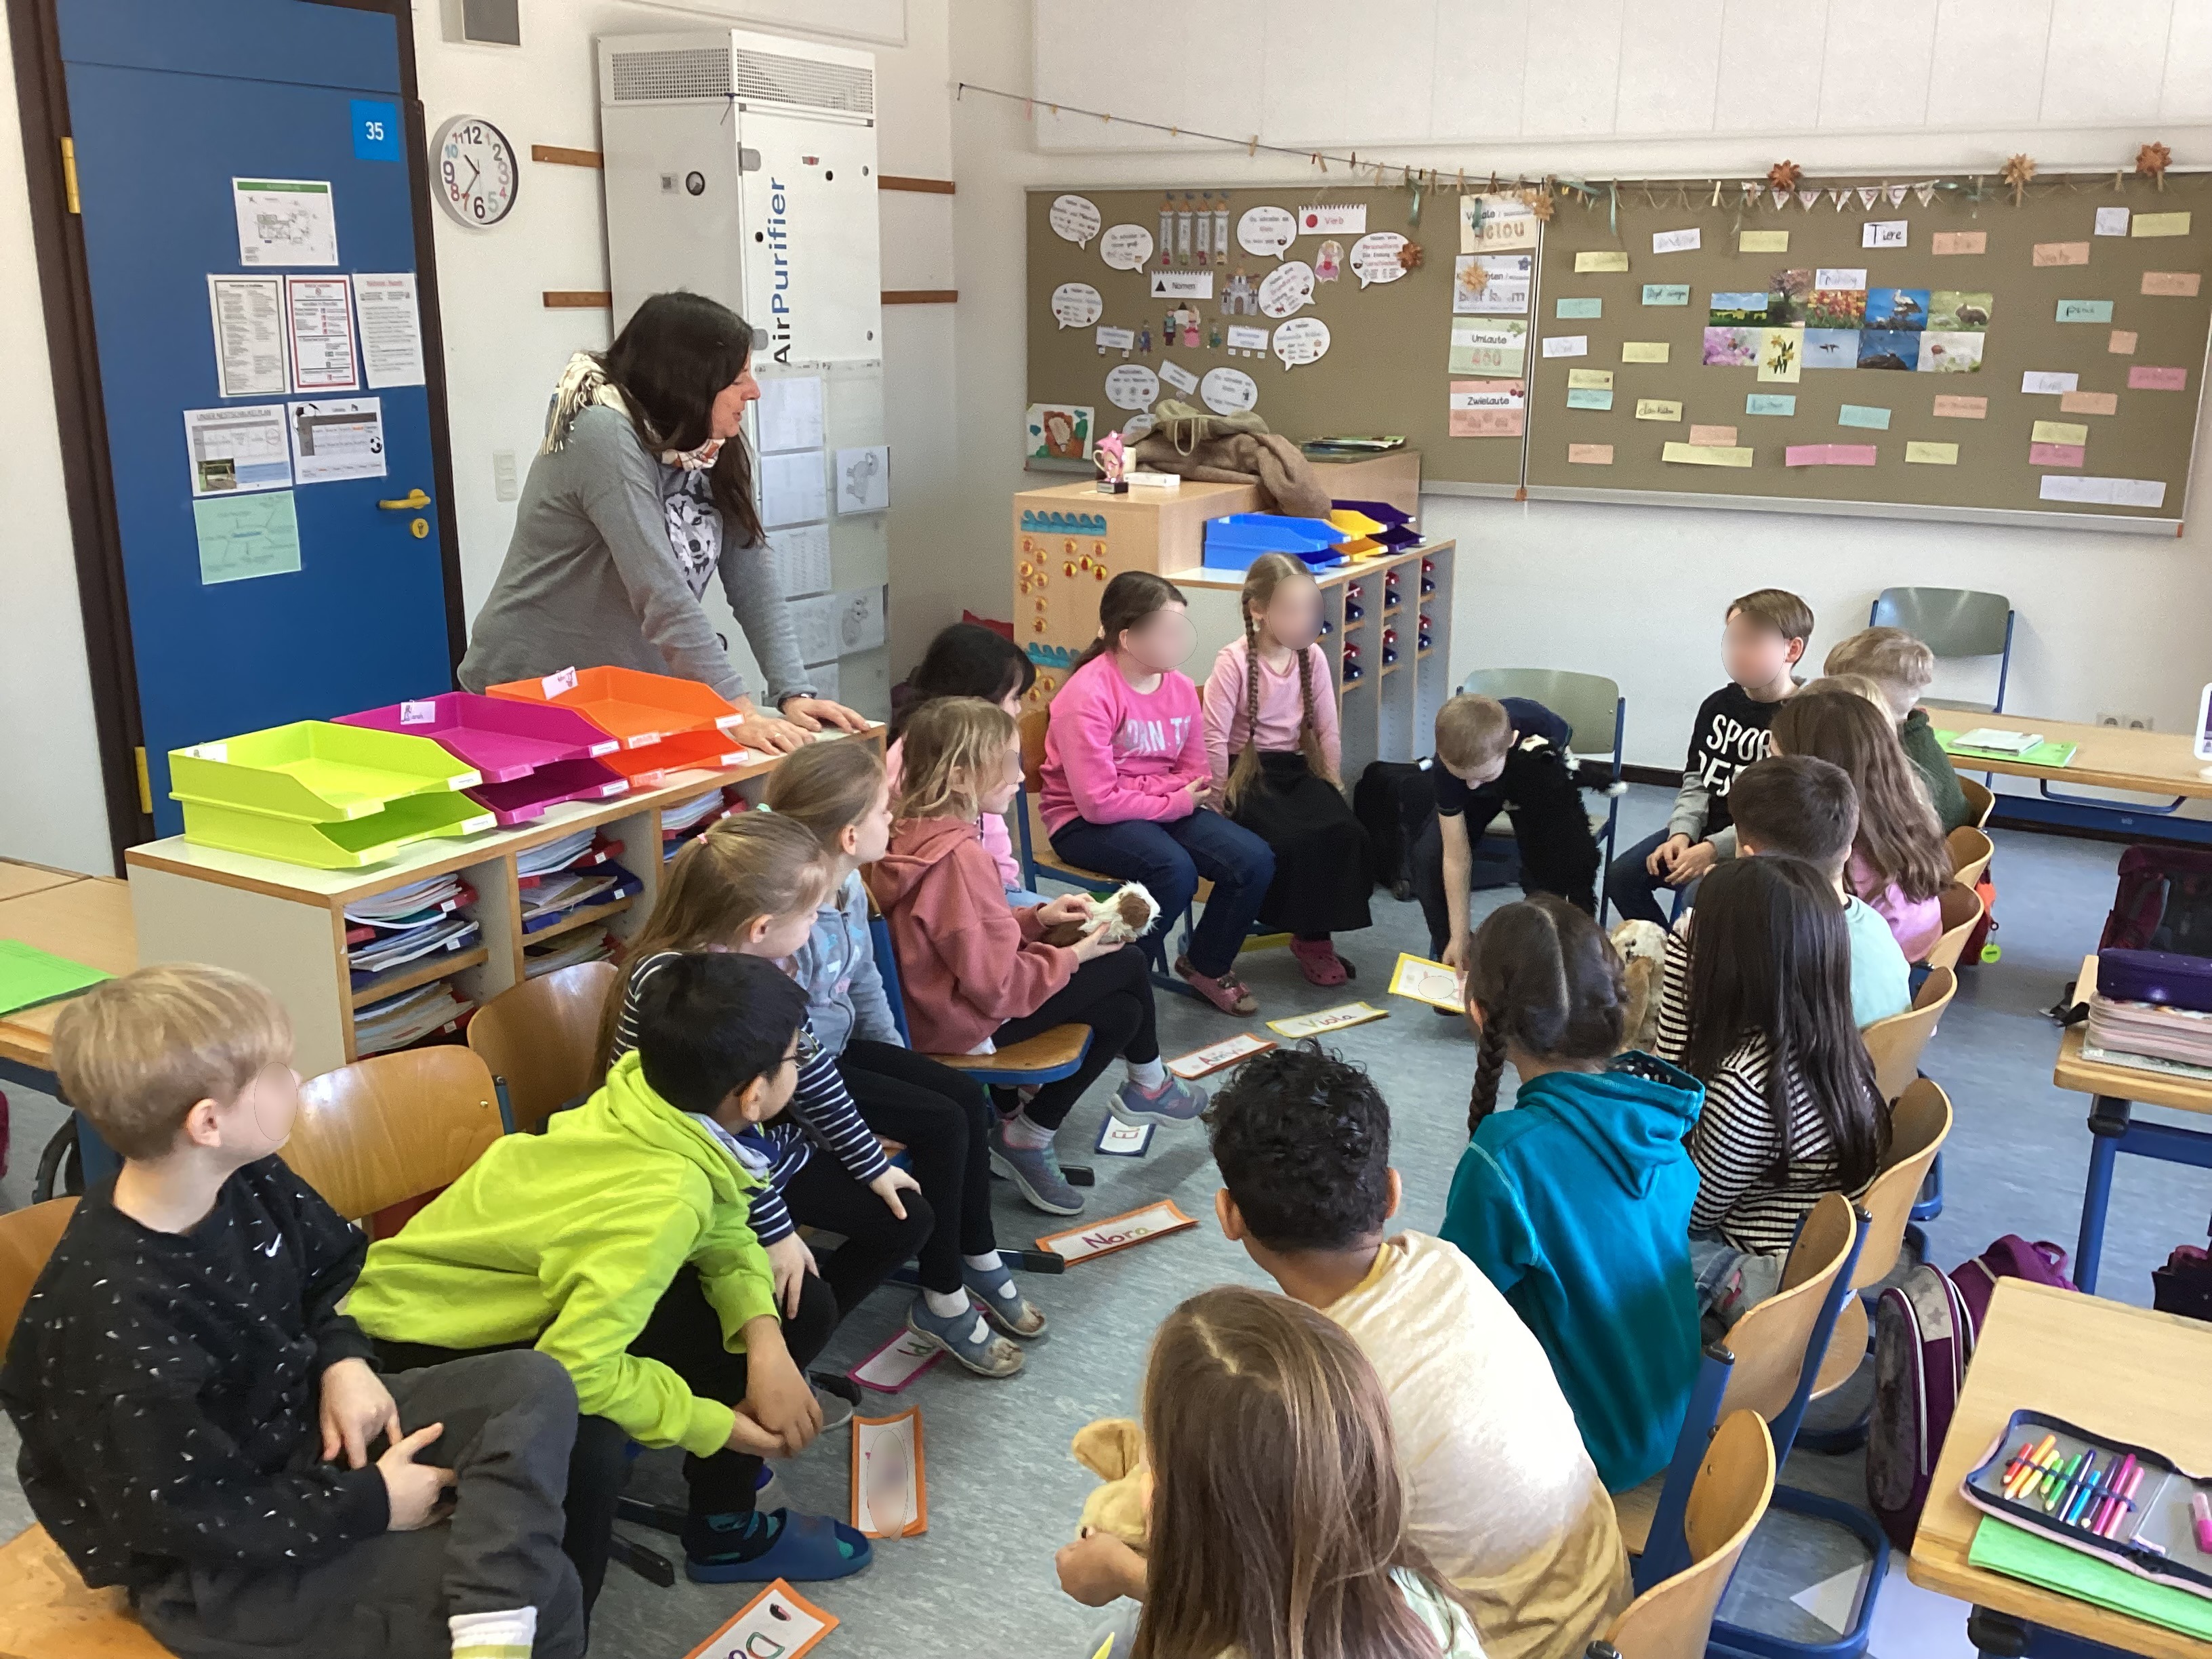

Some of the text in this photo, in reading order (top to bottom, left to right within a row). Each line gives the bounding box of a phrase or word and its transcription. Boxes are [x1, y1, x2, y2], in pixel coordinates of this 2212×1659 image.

[365, 121, 384, 140] 35
[452, 131, 464, 144] 11
[463, 126, 483, 144] 12
[485, 133, 491, 145] 1
[445, 144, 459, 159] 10
[492, 143, 502, 161] 2
[443, 161, 455, 184] 9
[498, 161, 509, 185] 3
[450, 182, 460, 201] 8
[499, 186, 507, 199] 4
[462, 192, 470, 211] 7
[474, 196, 486, 219] 6
[487, 191, 499, 213] 5
[1324, 216, 1345, 225] Verb
[1868, 224, 1902, 245] Tiere
[1471, 334, 1507, 344] Umlaute
[1467, 396, 1510, 406] Zwielaute
[1082, 1227, 1155, 1249] Nora
